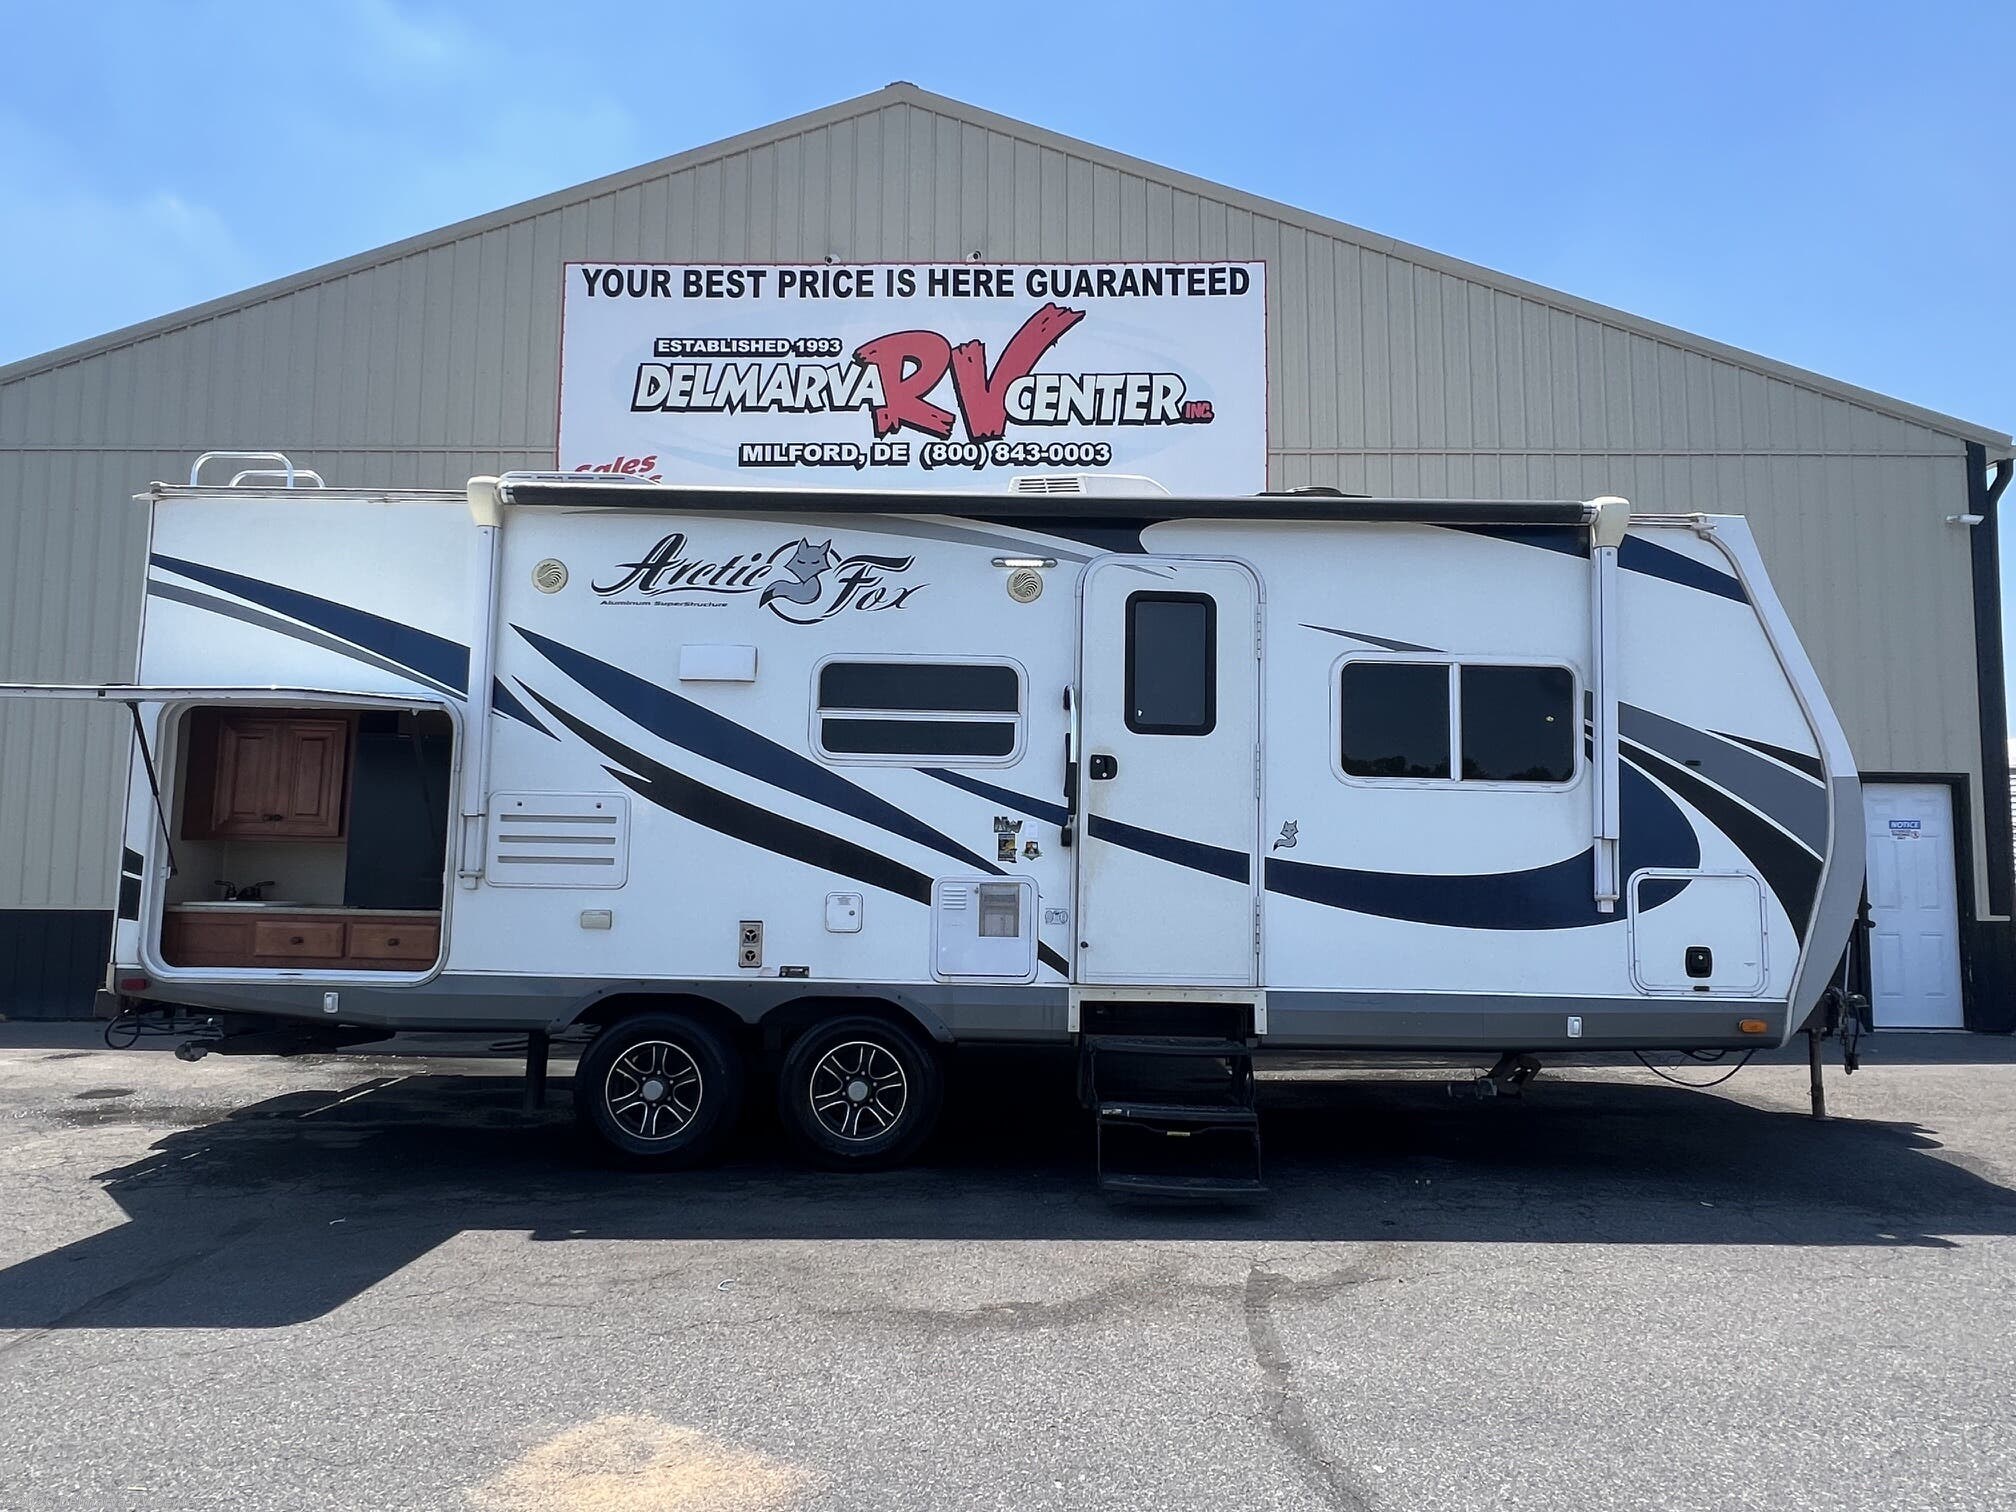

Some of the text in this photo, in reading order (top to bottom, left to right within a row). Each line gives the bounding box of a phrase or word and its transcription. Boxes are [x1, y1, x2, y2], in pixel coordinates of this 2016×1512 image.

[582, 267, 1250, 298] YOUR BEST PRICE IS HERE GUARANTEED
[656, 338, 842, 355] ESTABLISHED 1993
[633, 363, 887, 412] DELMARVA
[854, 302, 1085, 443] RV
[1004, 373, 1186, 424] CENTER
[741, 443, 1111, 468] MILFORD, DE (800) 843-0003
[591, 533, 931, 619] Arctic Fox
[1890, 821, 1918, 829] NOTICE
